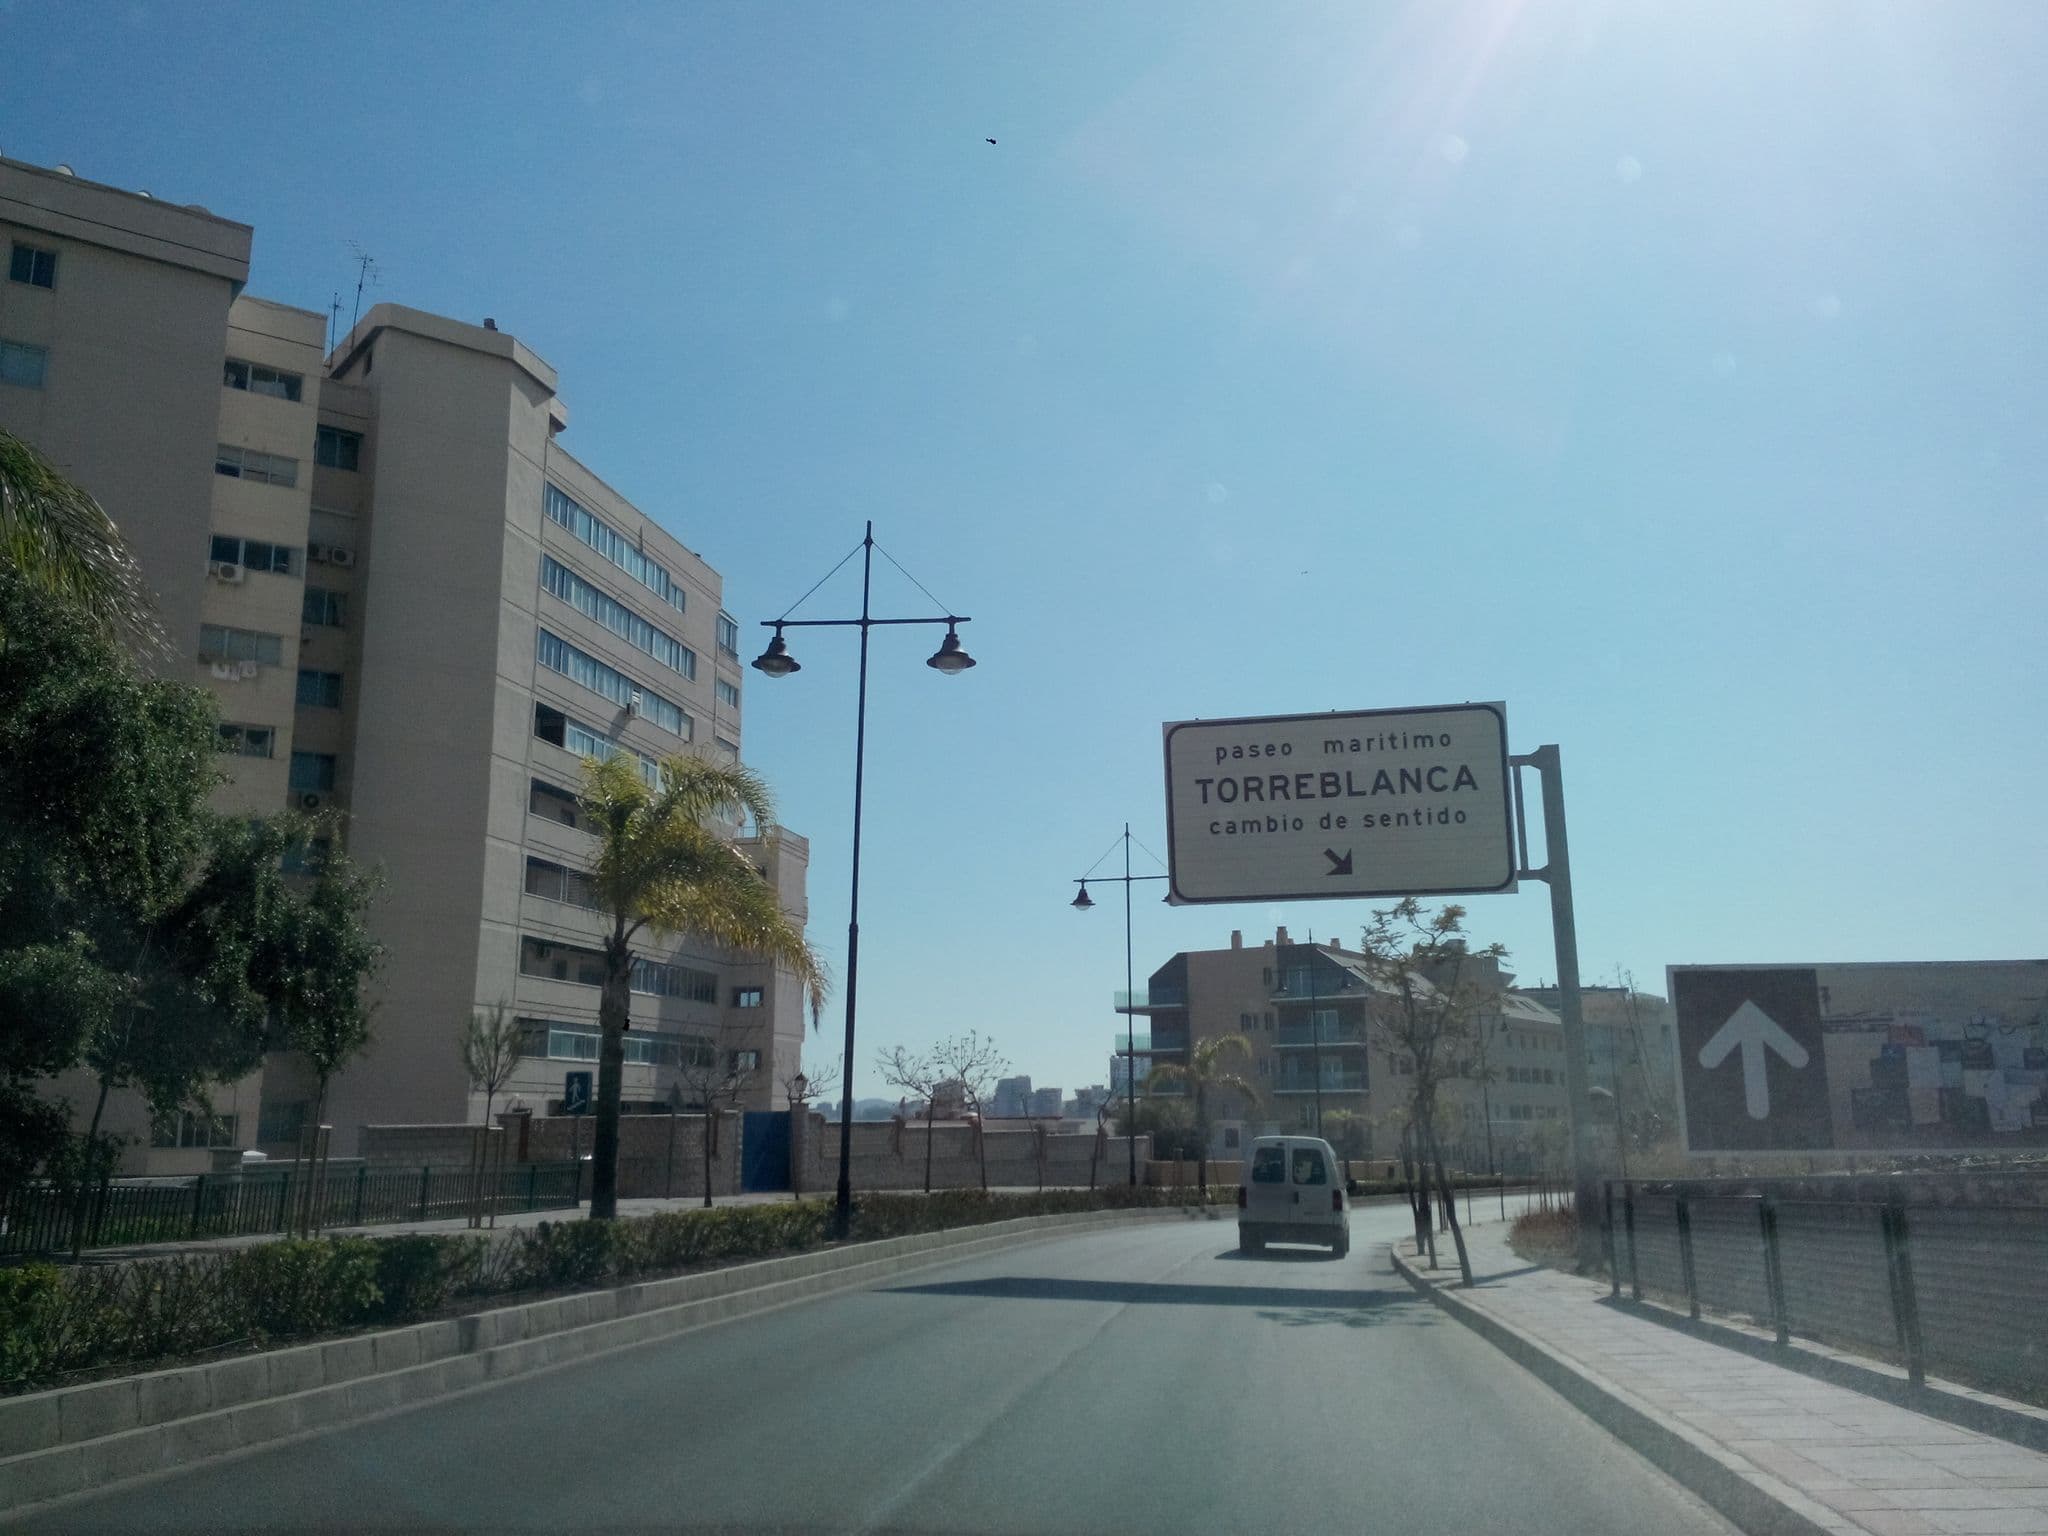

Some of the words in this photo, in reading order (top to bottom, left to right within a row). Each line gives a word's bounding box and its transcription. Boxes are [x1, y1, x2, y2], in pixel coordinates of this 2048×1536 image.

[1215, 742, 1293, 765] paseo
[1324, 731, 1452, 754] maritimo
[1196, 764, 1479, 804] TORREBLANCA
[1210, 813, 1303, 835] cambio
[1319, 812, 1347, 830] de
[1363, 807, 1467, 829] sentido
